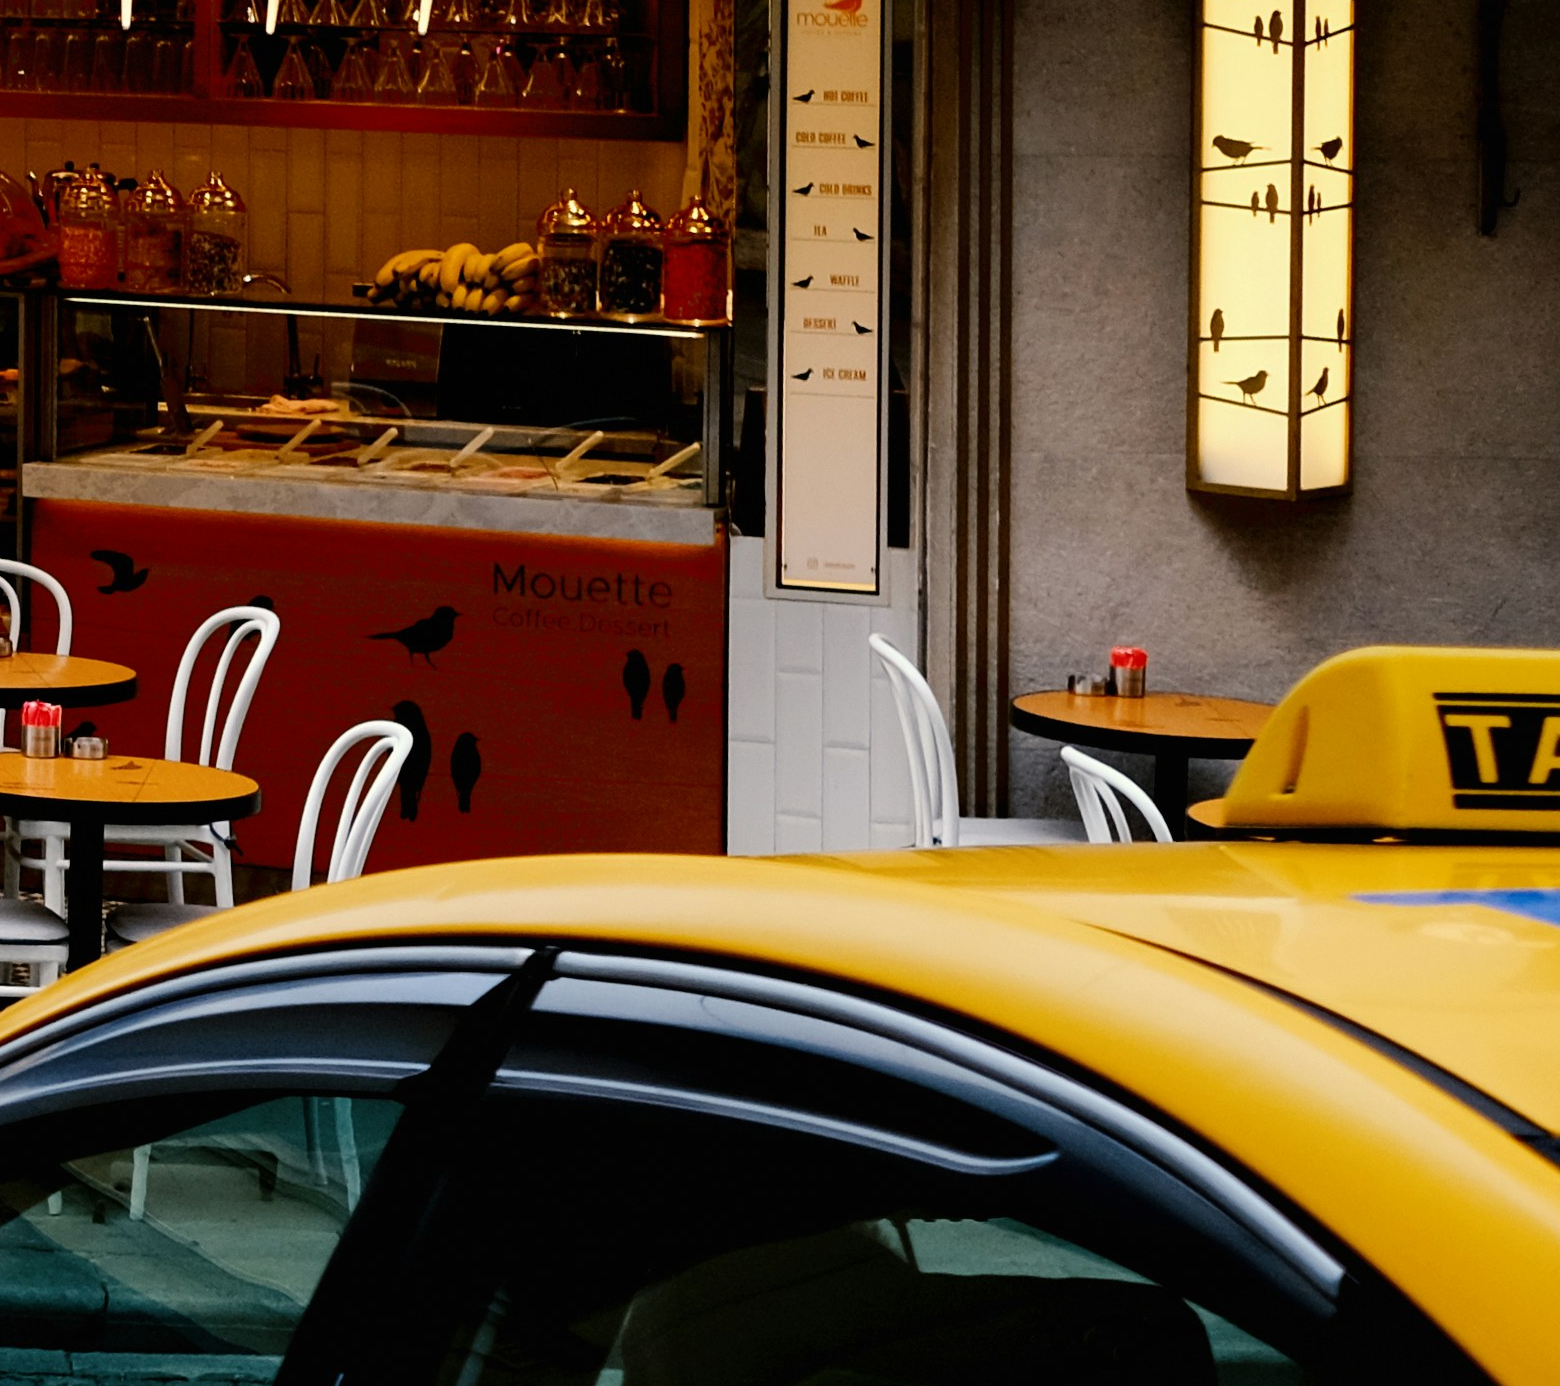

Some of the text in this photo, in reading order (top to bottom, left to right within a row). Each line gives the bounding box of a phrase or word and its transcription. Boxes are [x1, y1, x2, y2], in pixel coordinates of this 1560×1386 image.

[797, 10, 868, 28] mouette
[841, 91, 868, 104] COFFEE
[795, 131, 846, 145] COLD COFFEE
[819, 183, 872, 196] COLD DRINKS
[830, 274, 860, 287] WAFFLE
[803, 317, 836, 330] DESSERT
[493, 563, 673, 609] Mouette
